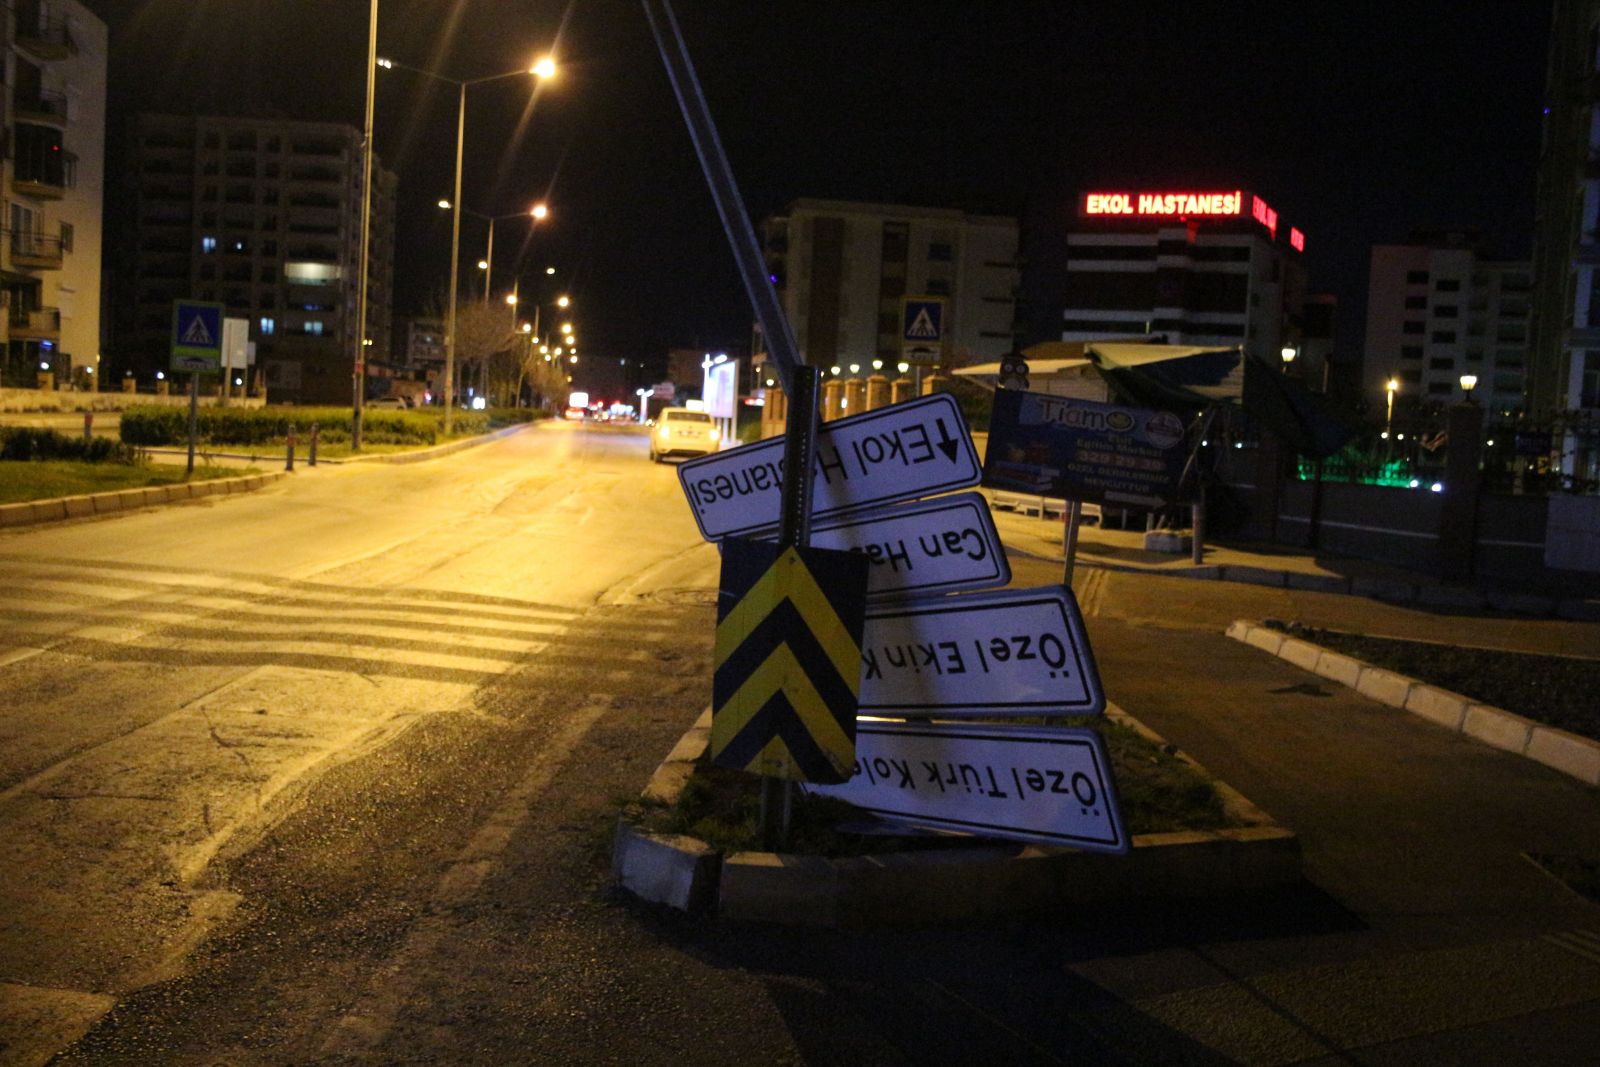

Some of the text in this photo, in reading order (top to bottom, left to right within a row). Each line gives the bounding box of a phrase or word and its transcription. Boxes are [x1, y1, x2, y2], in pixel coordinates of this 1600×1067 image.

[1086, 194, 1134, 214] EKOL
[1138, 190, 1242, 214] HASTANESİ
[690, 423, 936, 514] Ekol Htanesi
[919, 528, 986, 561] Can
[885, 639, 966, 675] Ekin
[975, 633, 1070, 678] Özel
[922, 761, 1007, 798] Türk
[1012, 767, 1100, 816] Özel
